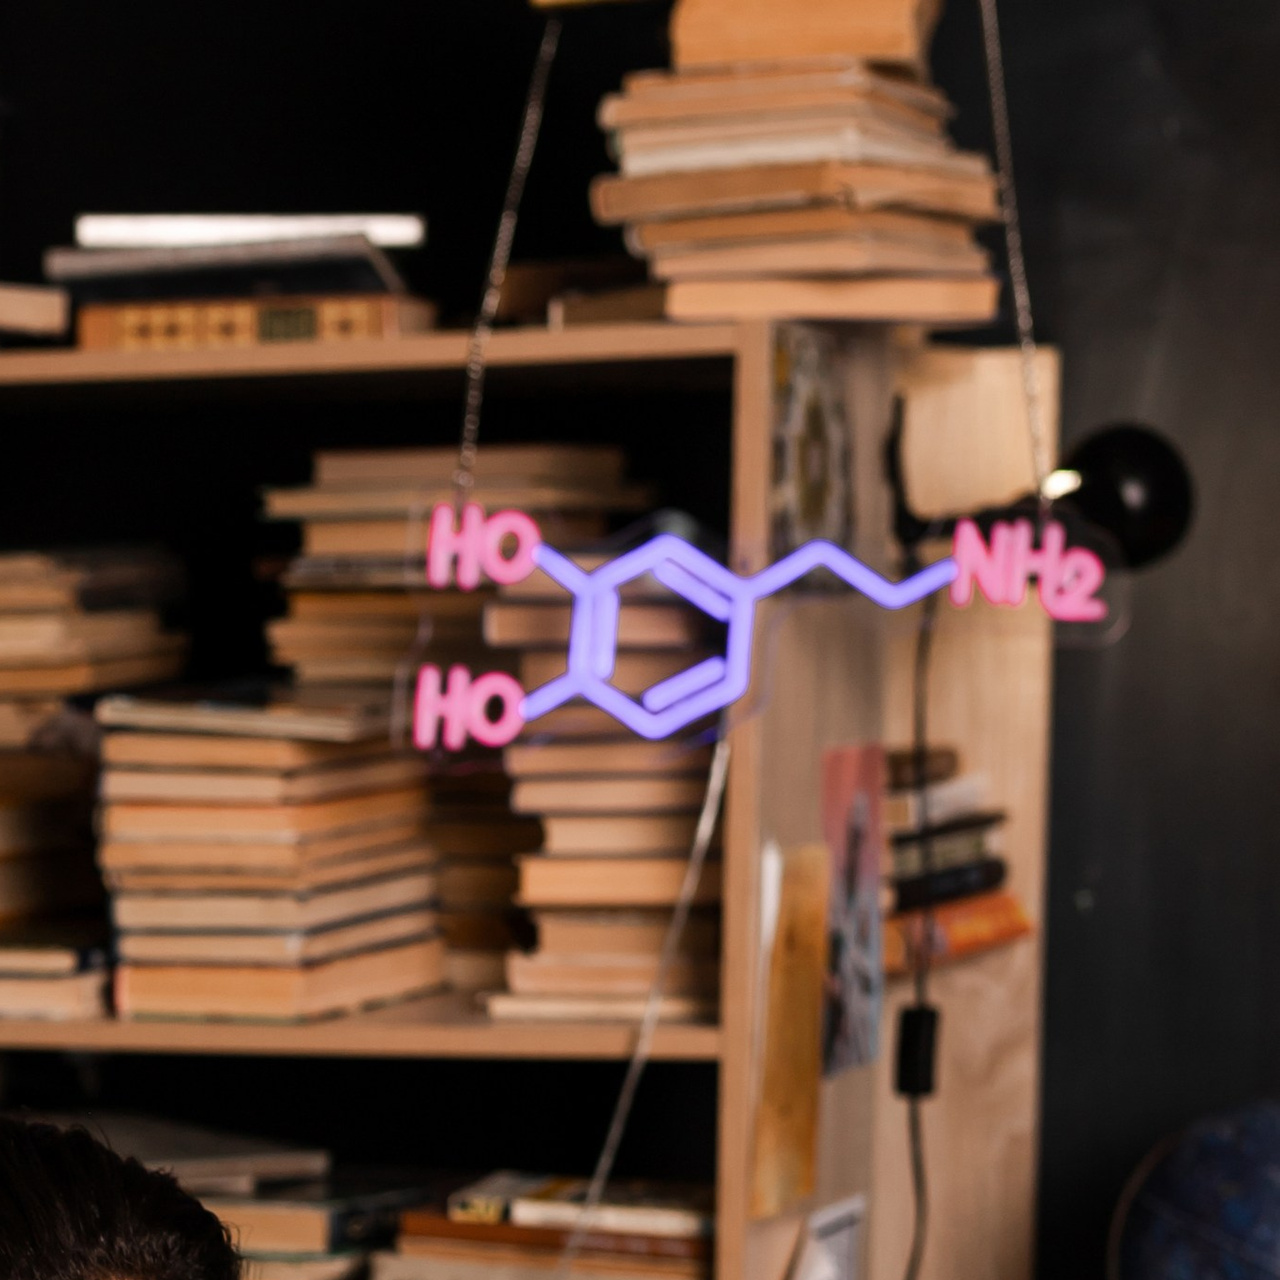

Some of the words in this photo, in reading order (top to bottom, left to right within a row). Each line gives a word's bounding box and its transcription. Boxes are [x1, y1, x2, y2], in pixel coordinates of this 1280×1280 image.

[427, 502, 542, 590] HO
[949, 517, 1109, 622] NH2
[413, 662, 527, 750] HO
